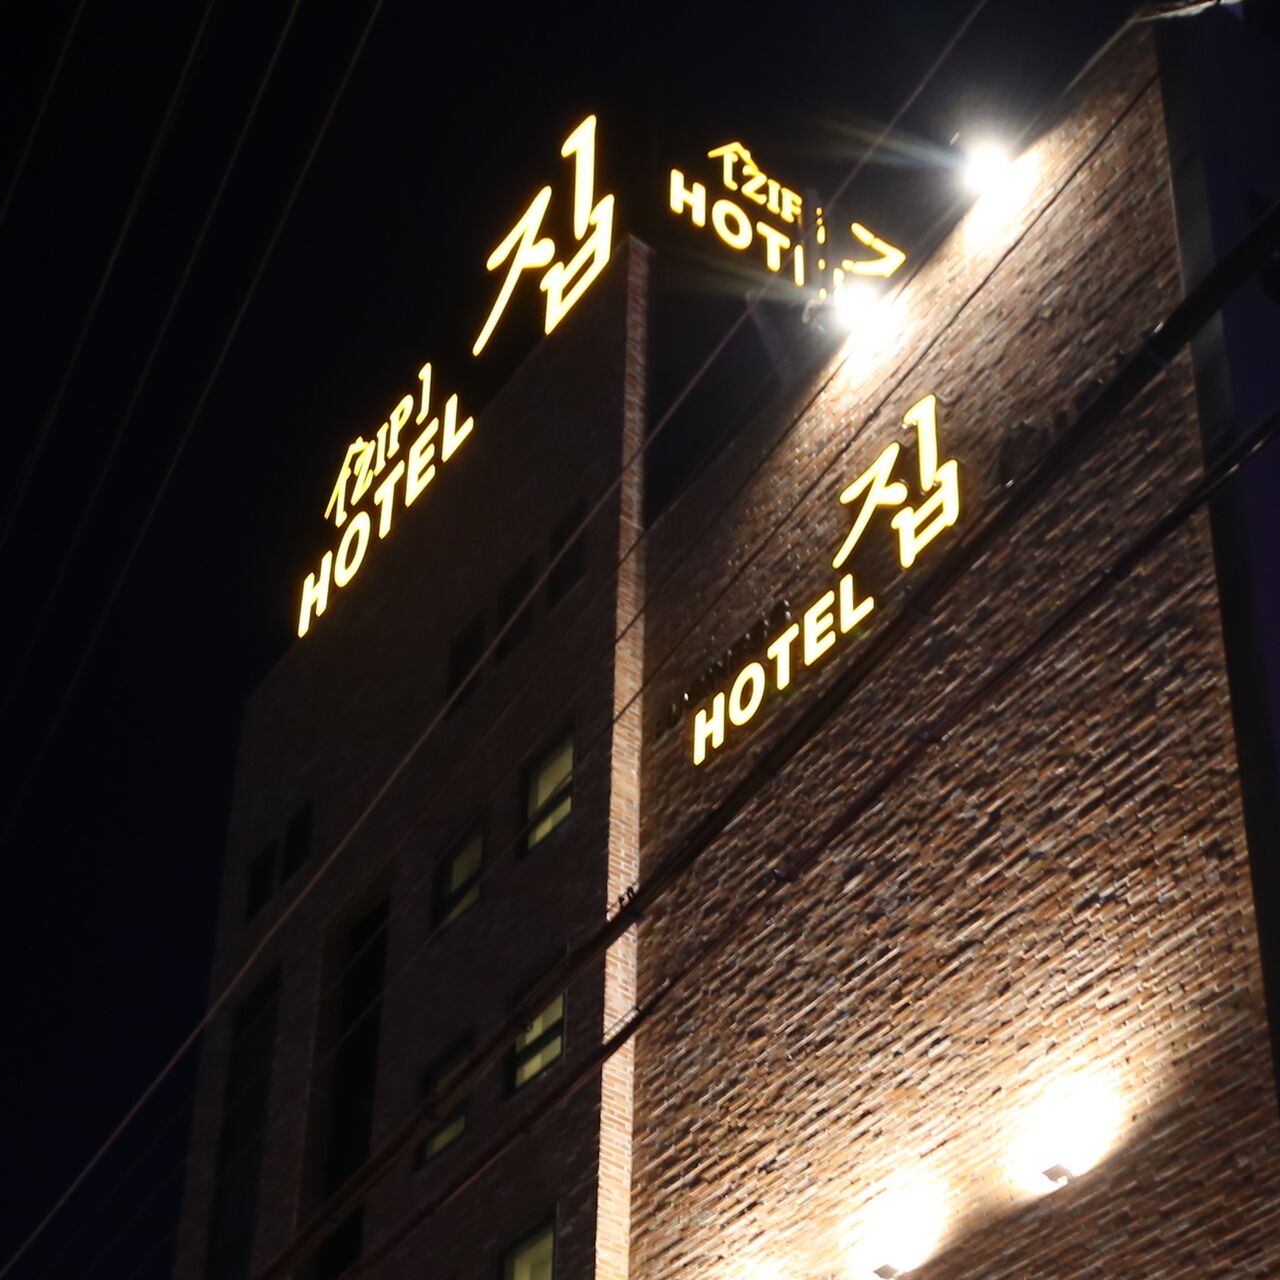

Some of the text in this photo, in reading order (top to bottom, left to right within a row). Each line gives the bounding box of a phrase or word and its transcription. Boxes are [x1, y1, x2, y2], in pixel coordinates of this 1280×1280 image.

[473, 114, 615, 357] 집
[297, 393, 474, 638] HOTEL
[693, 573, 874, 765] HOTEL
[832, 394, 959, 568] 집
